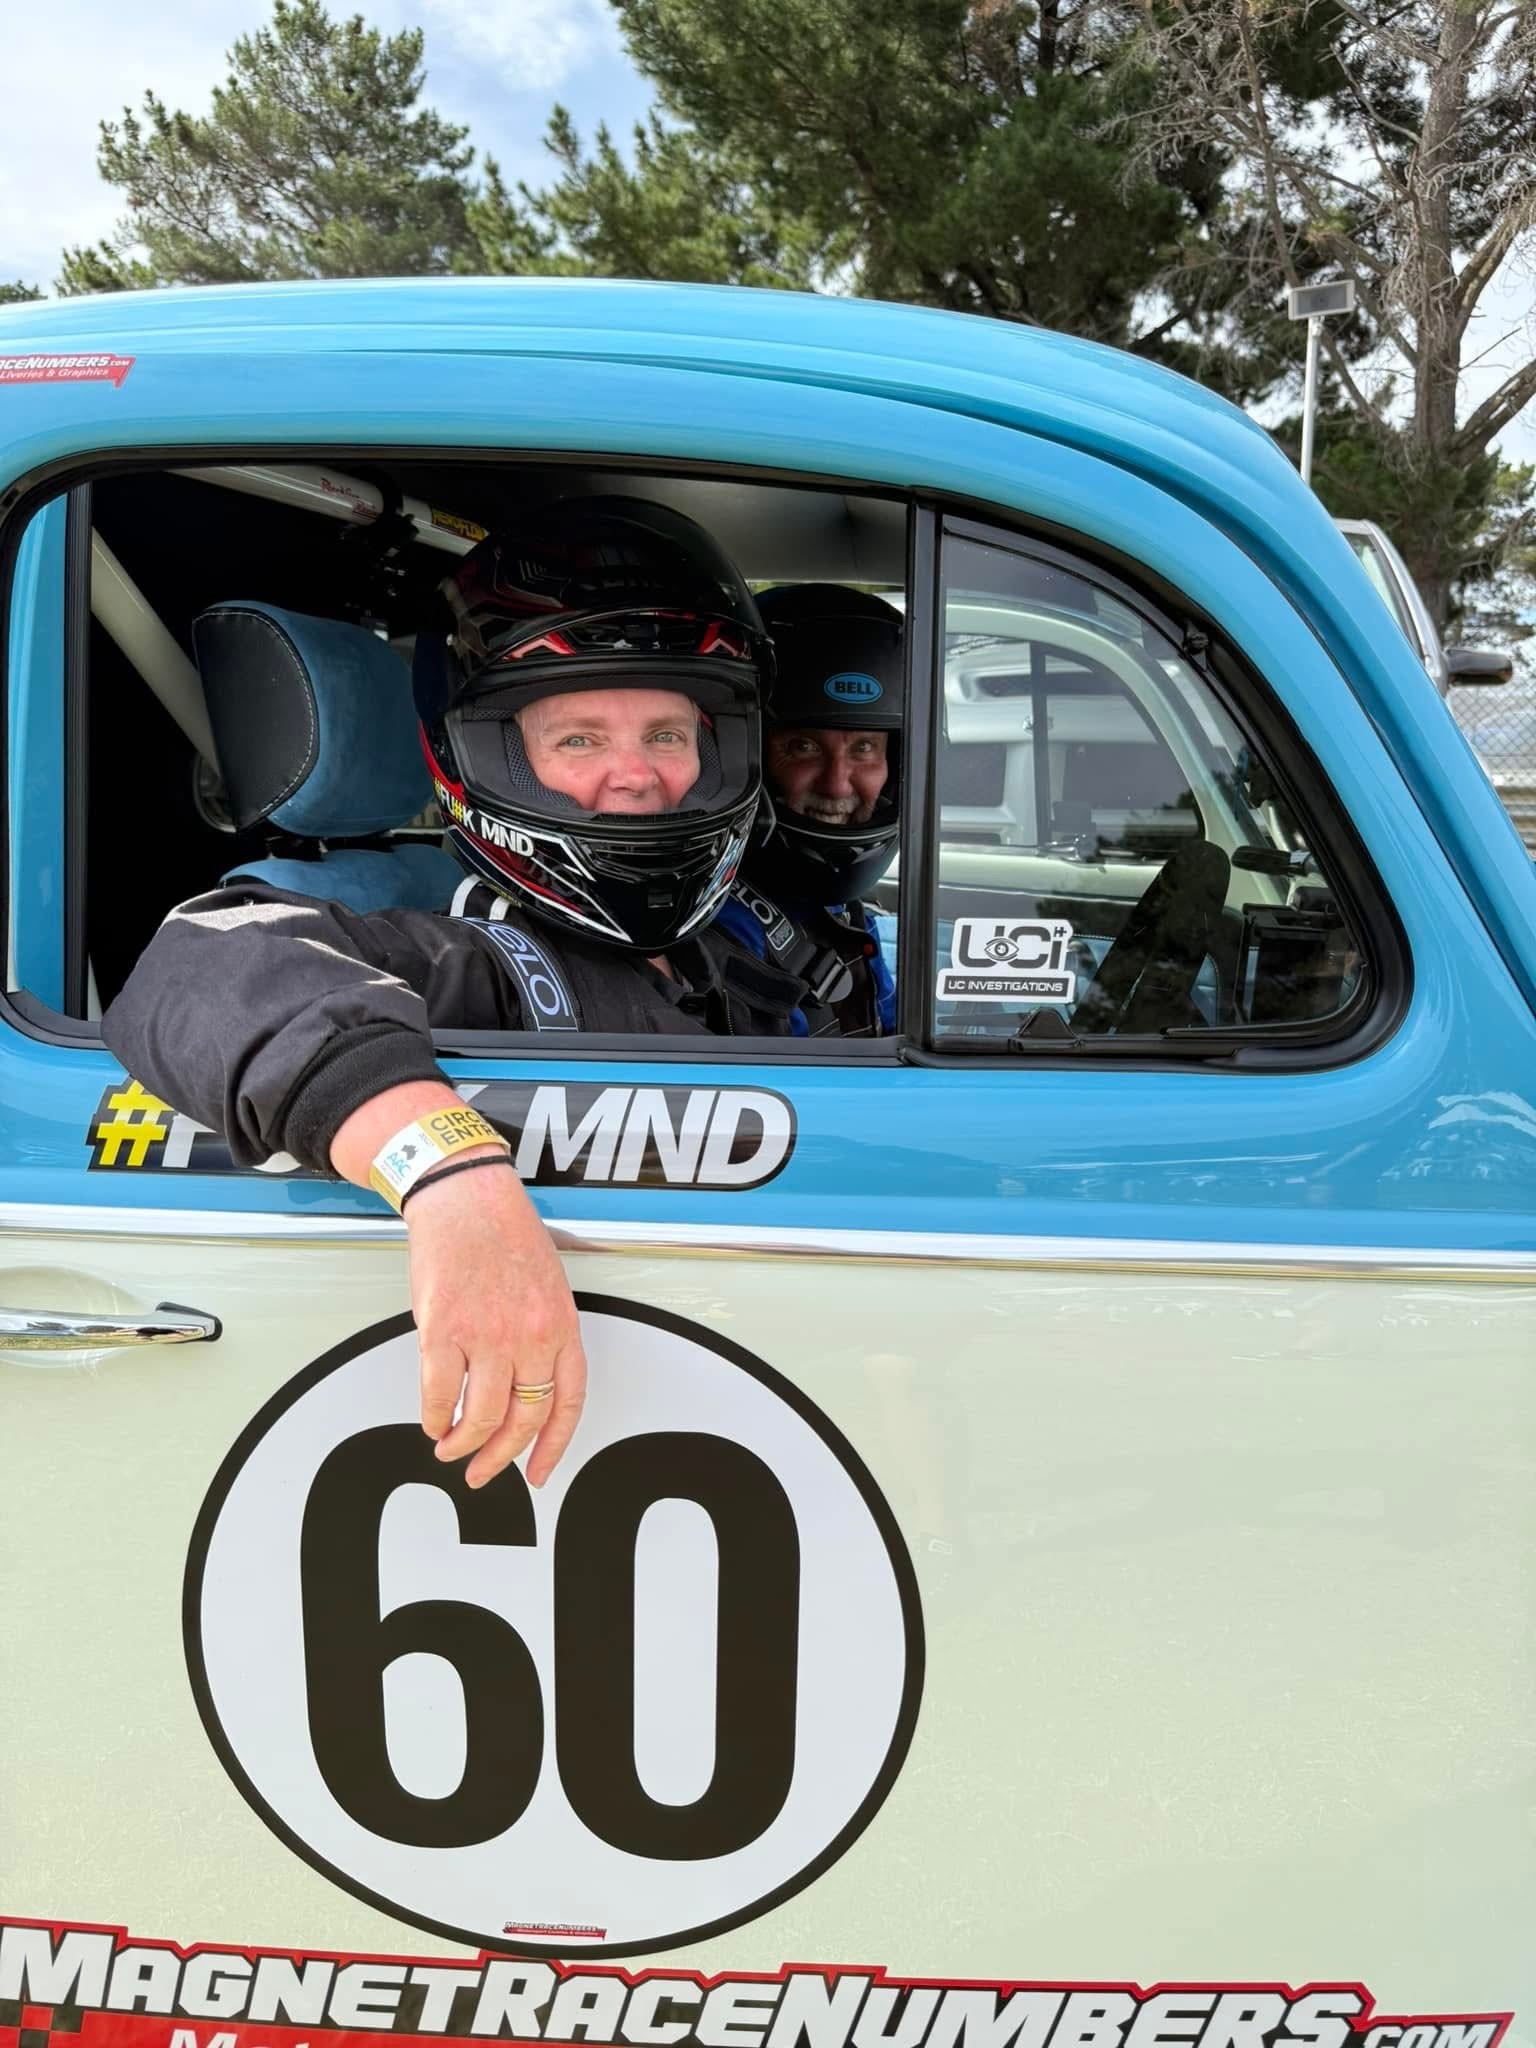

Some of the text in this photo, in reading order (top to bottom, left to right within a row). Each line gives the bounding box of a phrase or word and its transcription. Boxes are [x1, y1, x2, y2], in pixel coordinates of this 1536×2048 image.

[0, 366, 109, 379] Liveries & Graphics
[834, 680, 874, 695] BELL
[481, 816, 534, 857] MND
[948, 979, 1064, 992] UC INVESTIGATIONS
[515, 1085, 791, 1185] MND
[299, 1422, 801, 1862] 60
